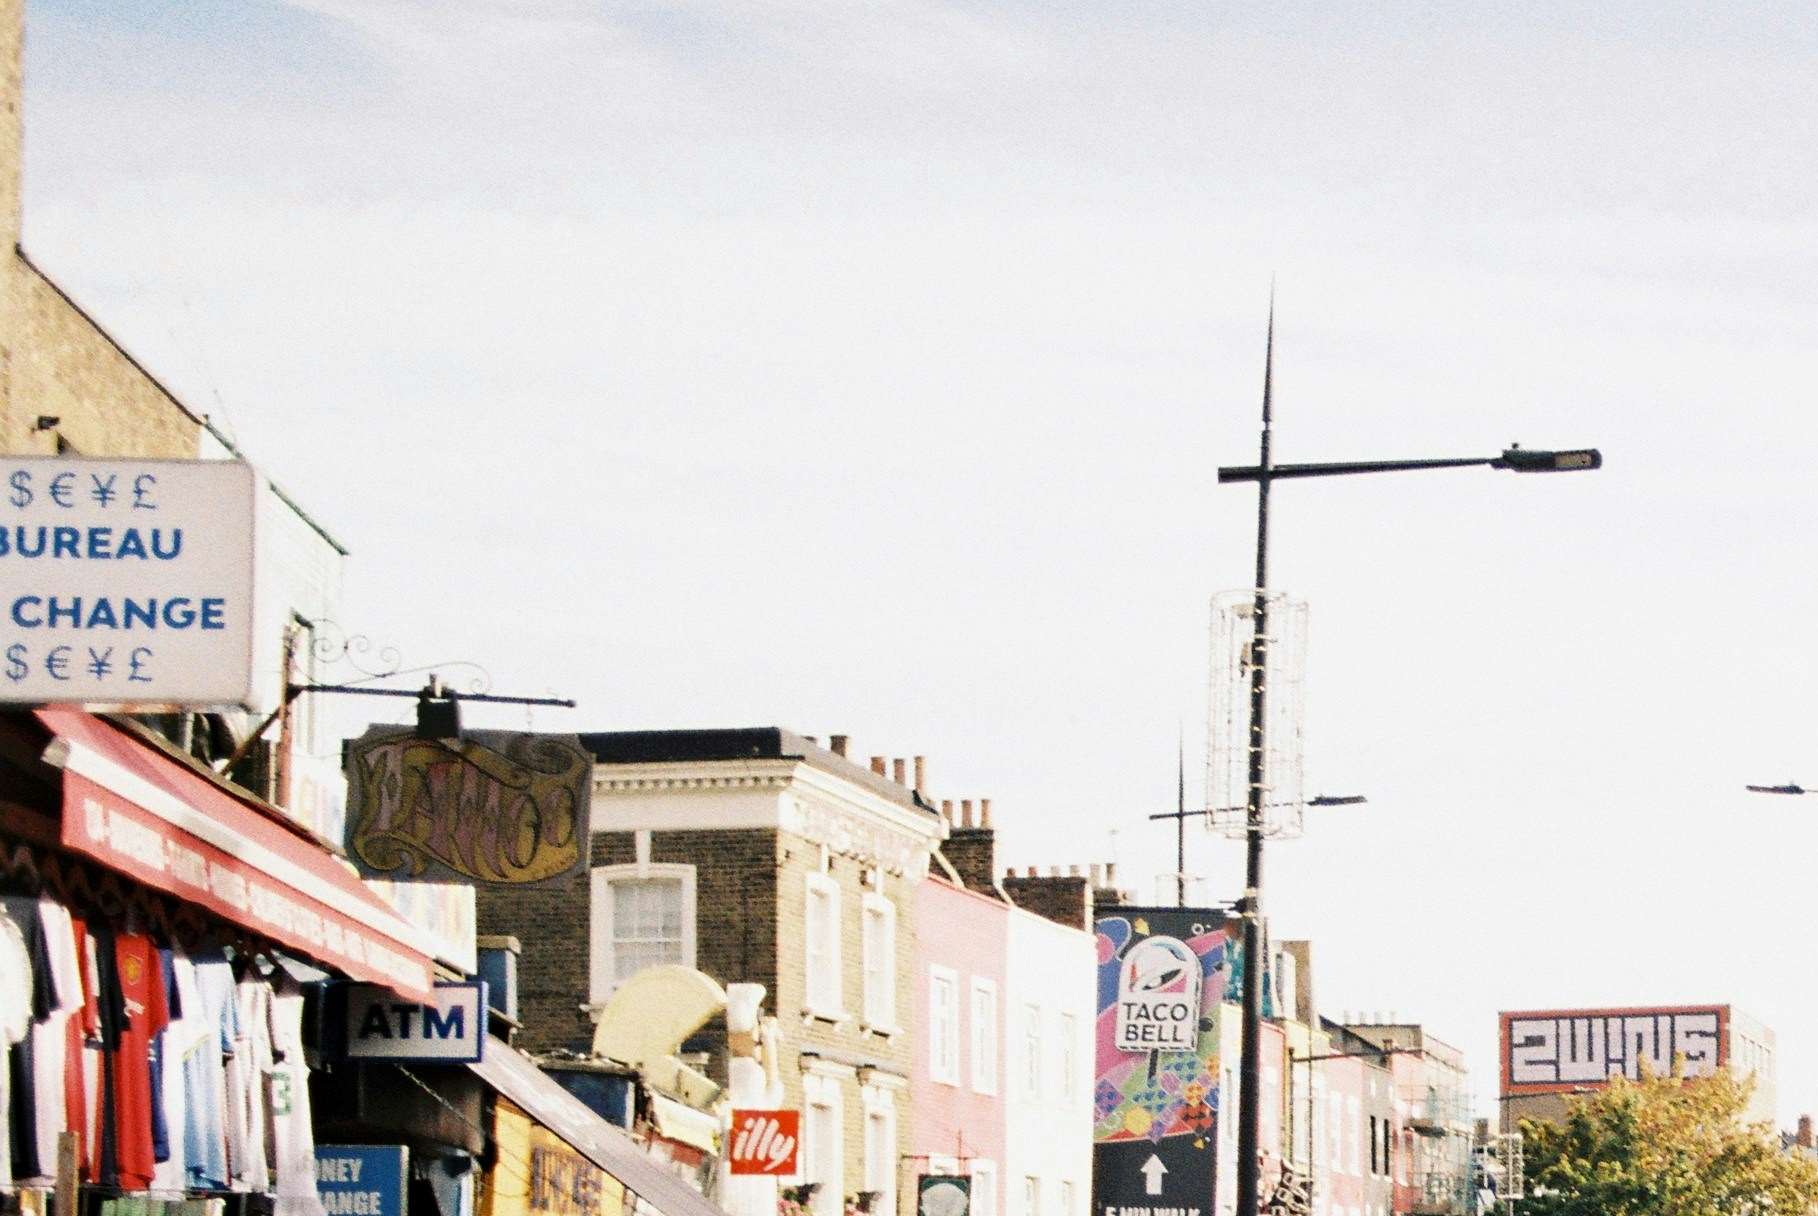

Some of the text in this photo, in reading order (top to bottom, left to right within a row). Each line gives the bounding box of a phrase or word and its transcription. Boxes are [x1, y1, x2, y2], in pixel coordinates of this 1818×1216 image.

[11, 596, 225, 630] CHANGE
[361, 1004, 465, 1040] ATM
[1122, 1002, 1188, 1021] TACO
[1125, 1023, 1185, 1043] BELL
[734, 1119, 796, 1171] illy
